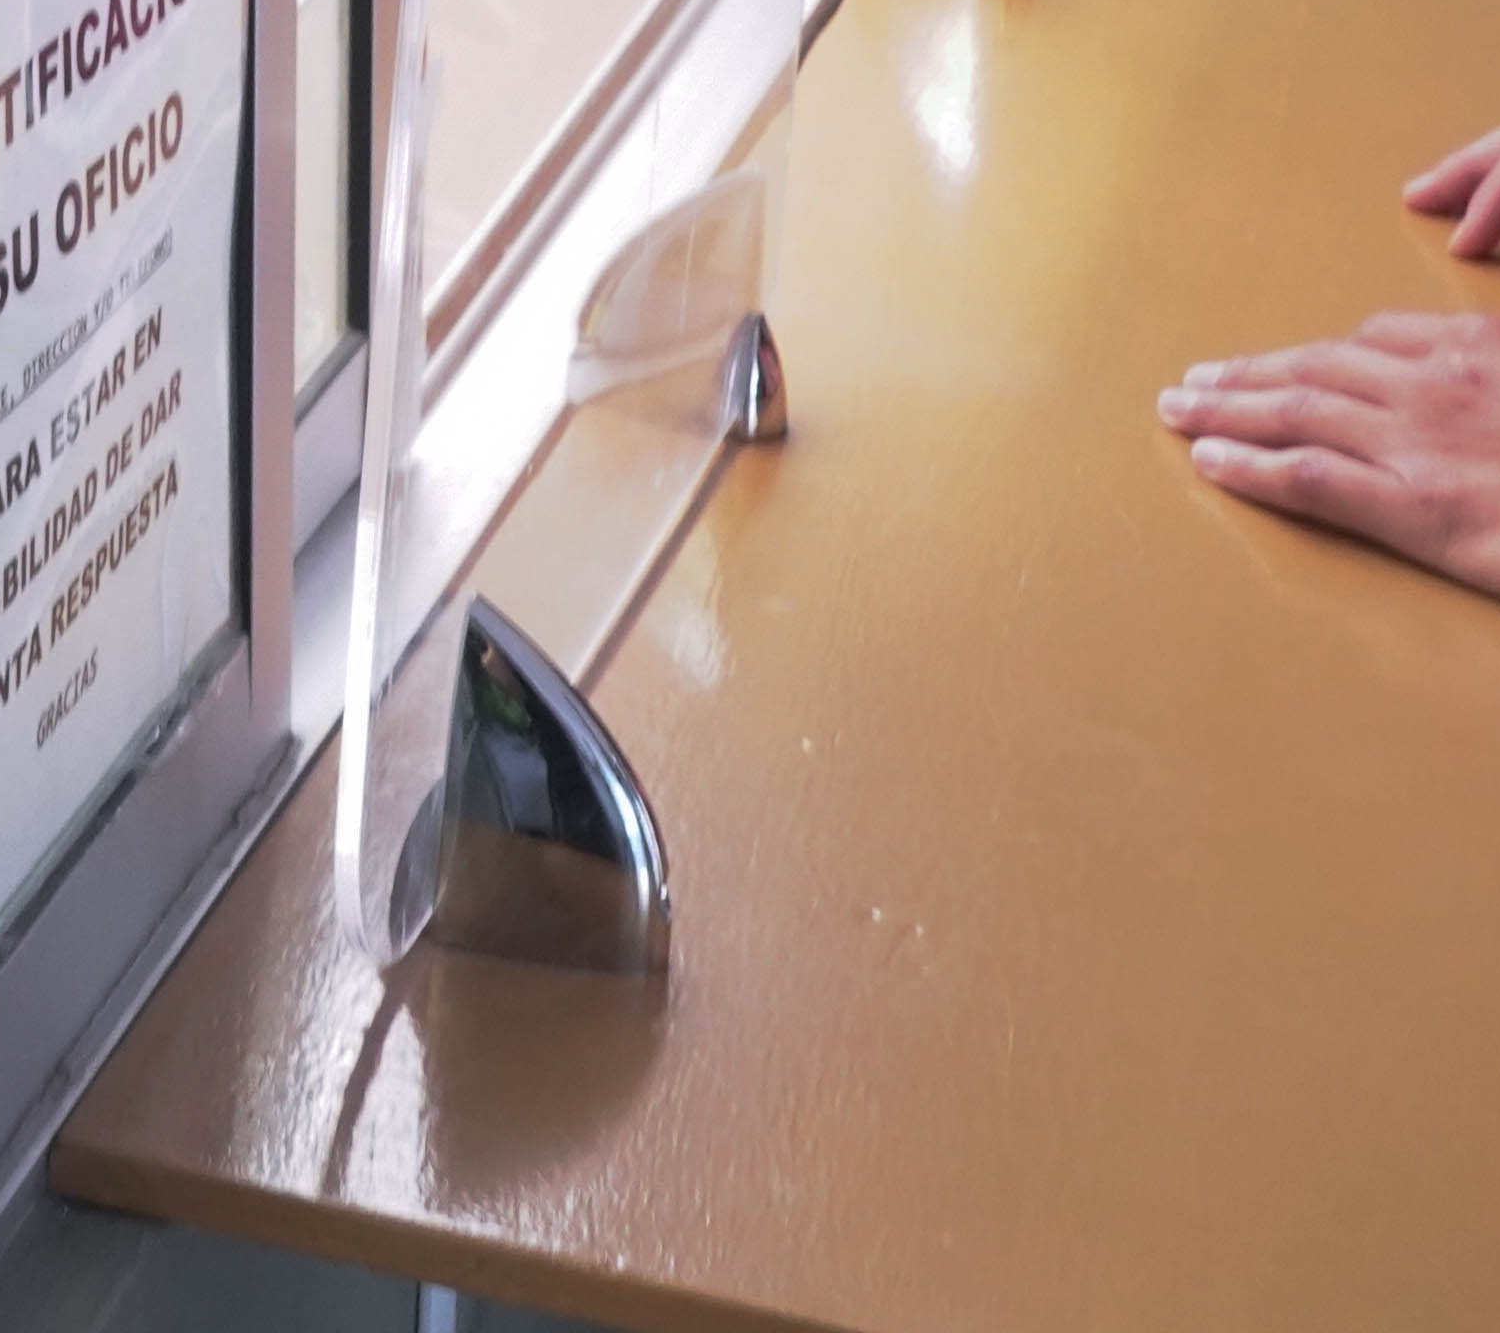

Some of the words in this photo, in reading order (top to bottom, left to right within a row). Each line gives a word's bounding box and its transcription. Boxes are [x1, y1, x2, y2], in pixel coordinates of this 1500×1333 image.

[55, 89, 184, 257] OFICIO
[50, 345, 127, 462] ESTAR
[133, 304, 163, 375] EN
[105, 423, 134, 491] DE
[140, 367, 182, 451] DAR
[50, 456, 179, 649] RESPUESTA
[36, 645, 99, 751] GRACIAS
